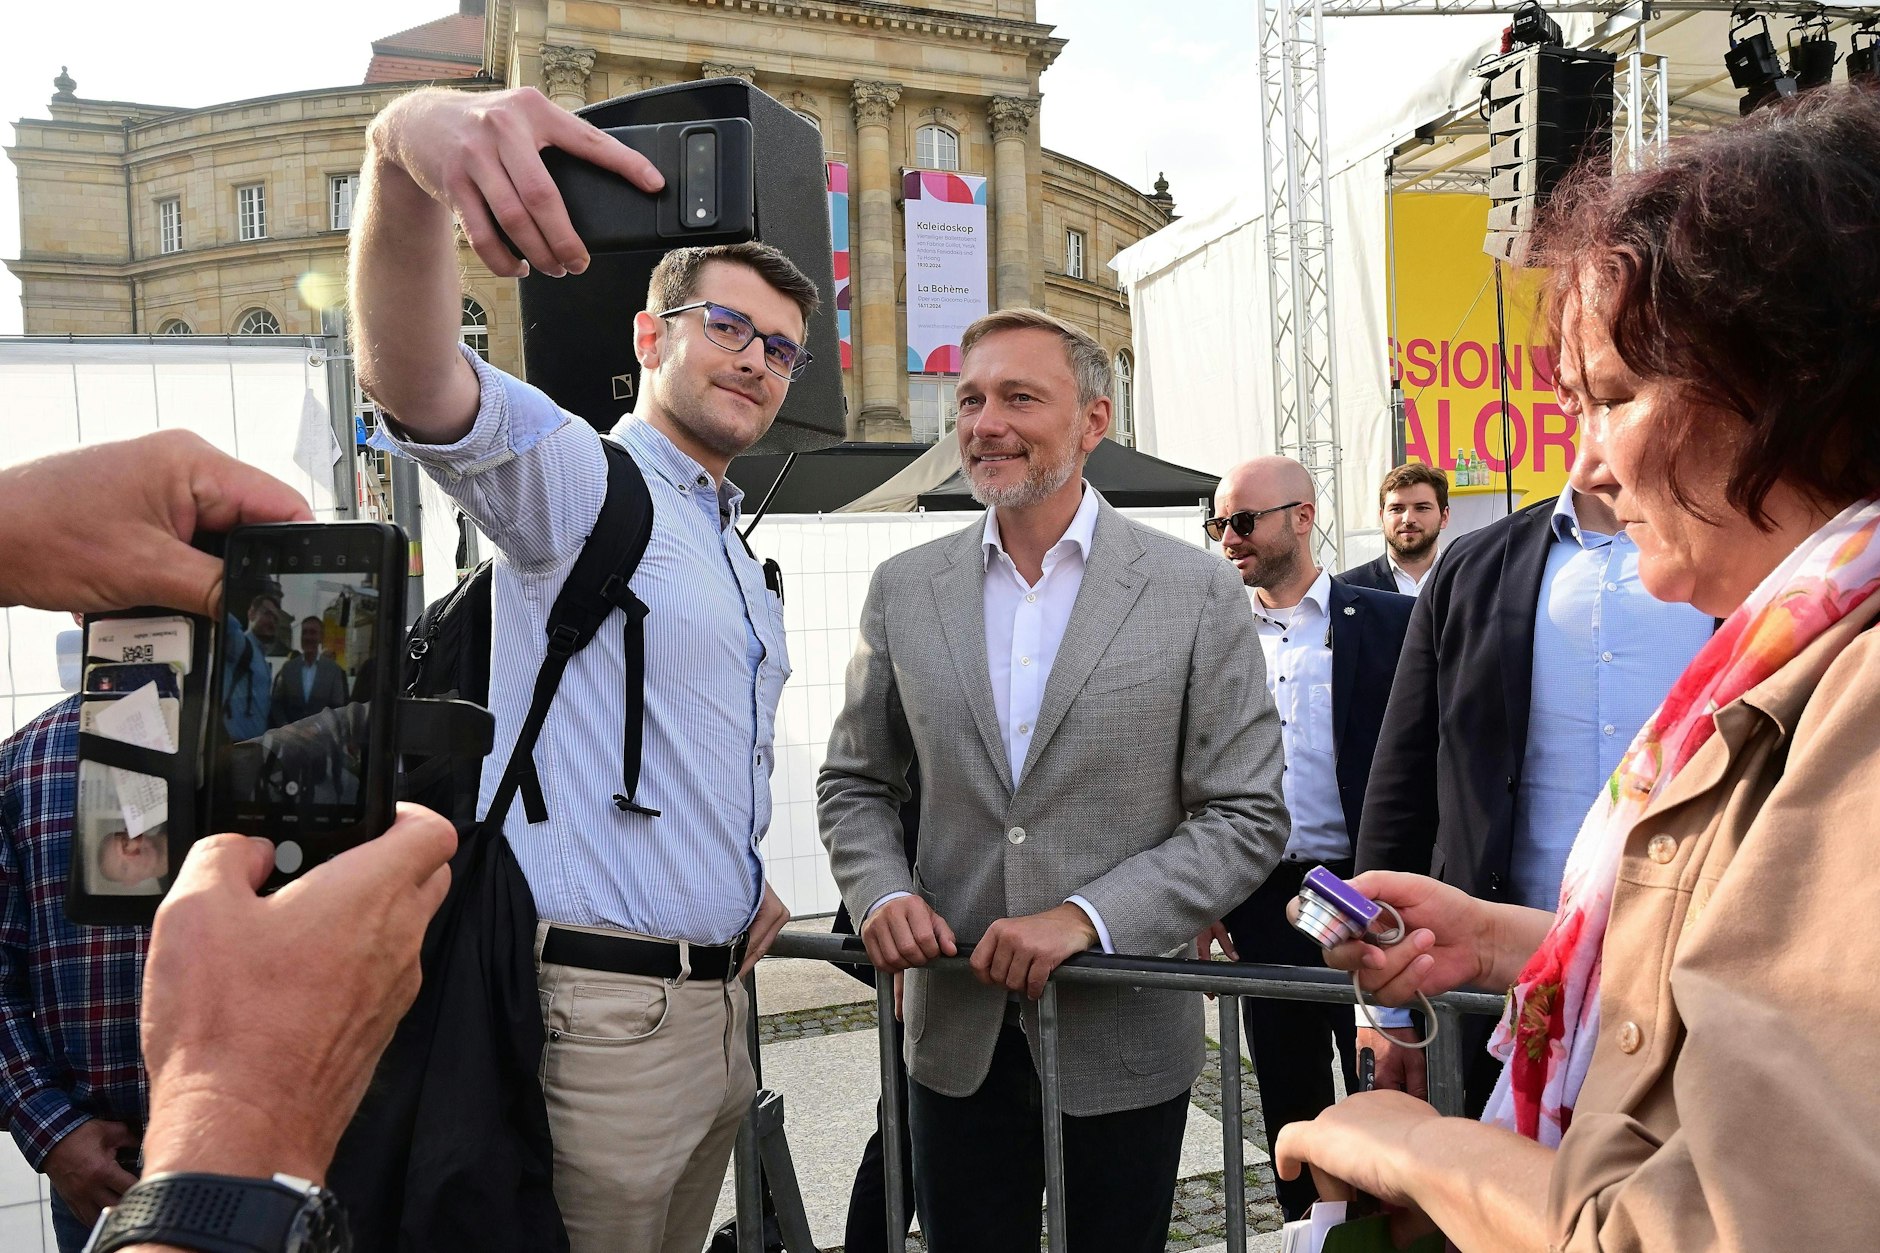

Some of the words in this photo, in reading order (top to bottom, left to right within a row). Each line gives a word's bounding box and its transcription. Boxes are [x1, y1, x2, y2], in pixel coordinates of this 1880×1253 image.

[916, 221, 974, 234] Kaleidoskop
[917, 283, 929, 292] La
[931, 284, 970, 294] Bohème
